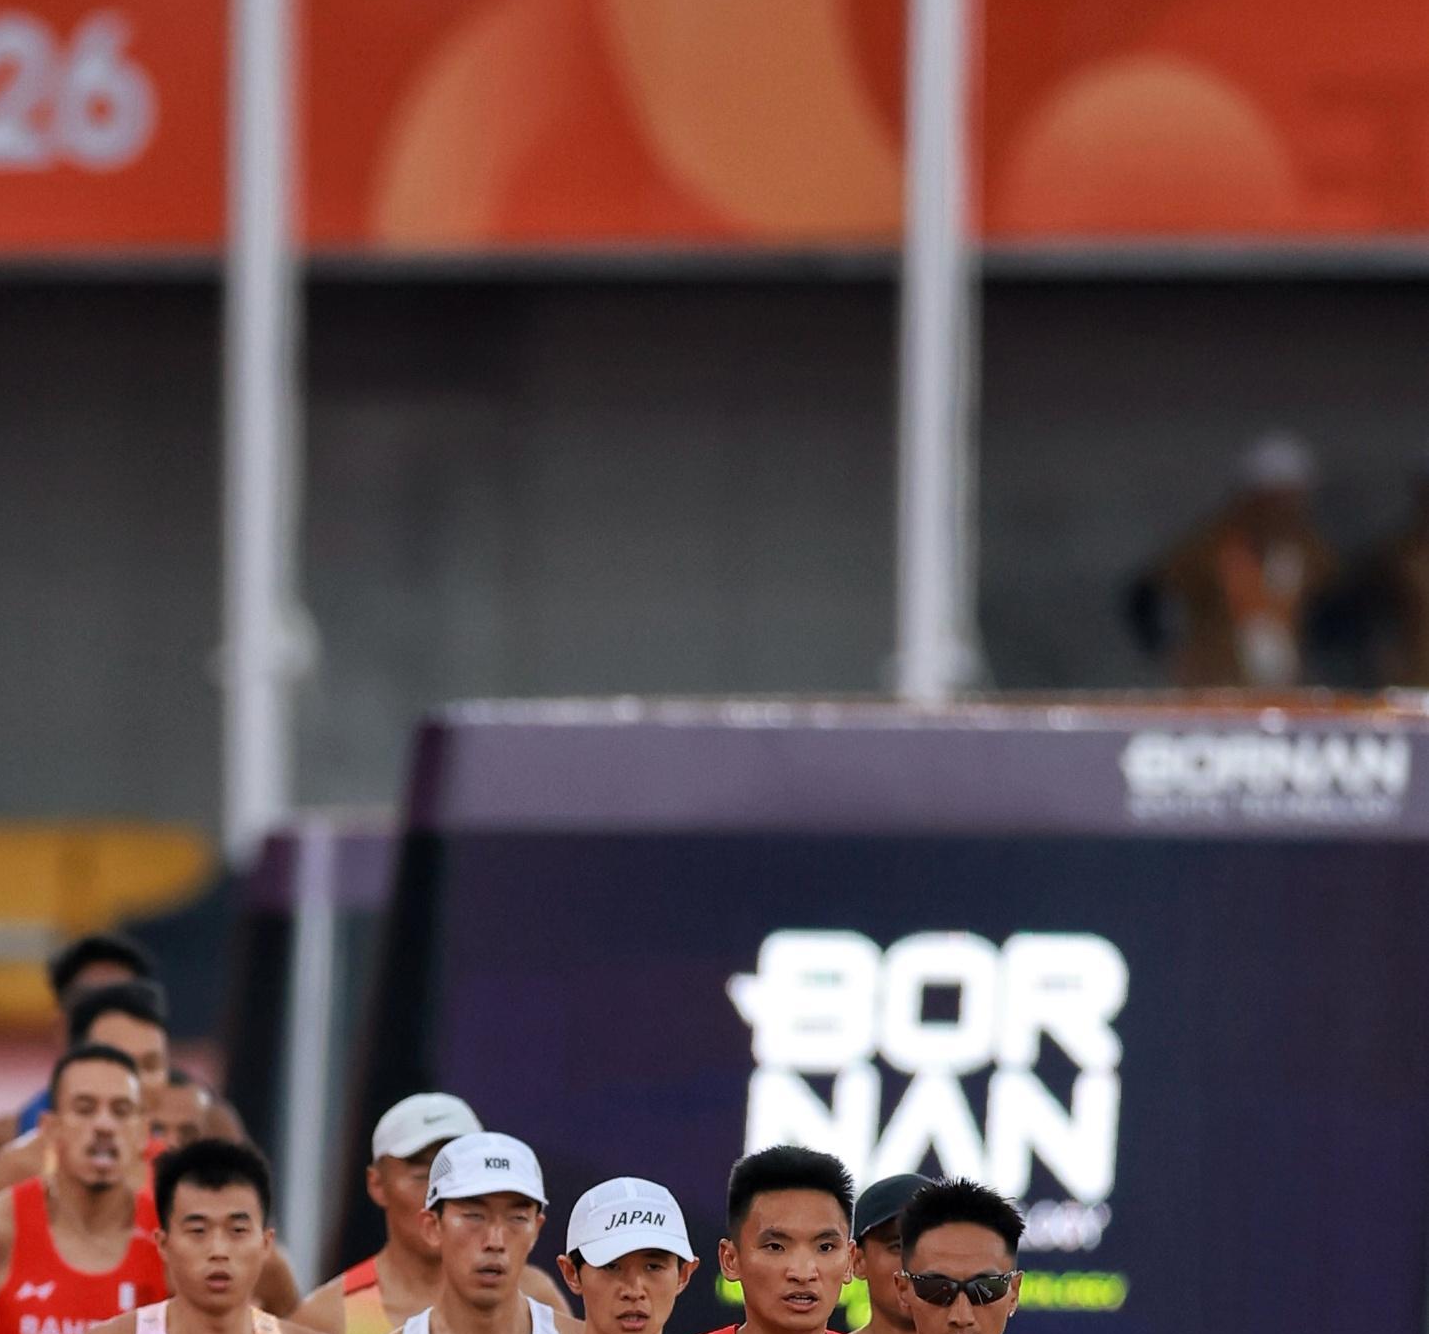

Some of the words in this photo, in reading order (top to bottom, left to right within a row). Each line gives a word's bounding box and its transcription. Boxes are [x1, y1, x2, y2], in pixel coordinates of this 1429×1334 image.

[726, 929, 1129, 1073] BOR
[484, 1157, 510, 1171] KOR
[604, 1210, 666, 1231] JAPAN
